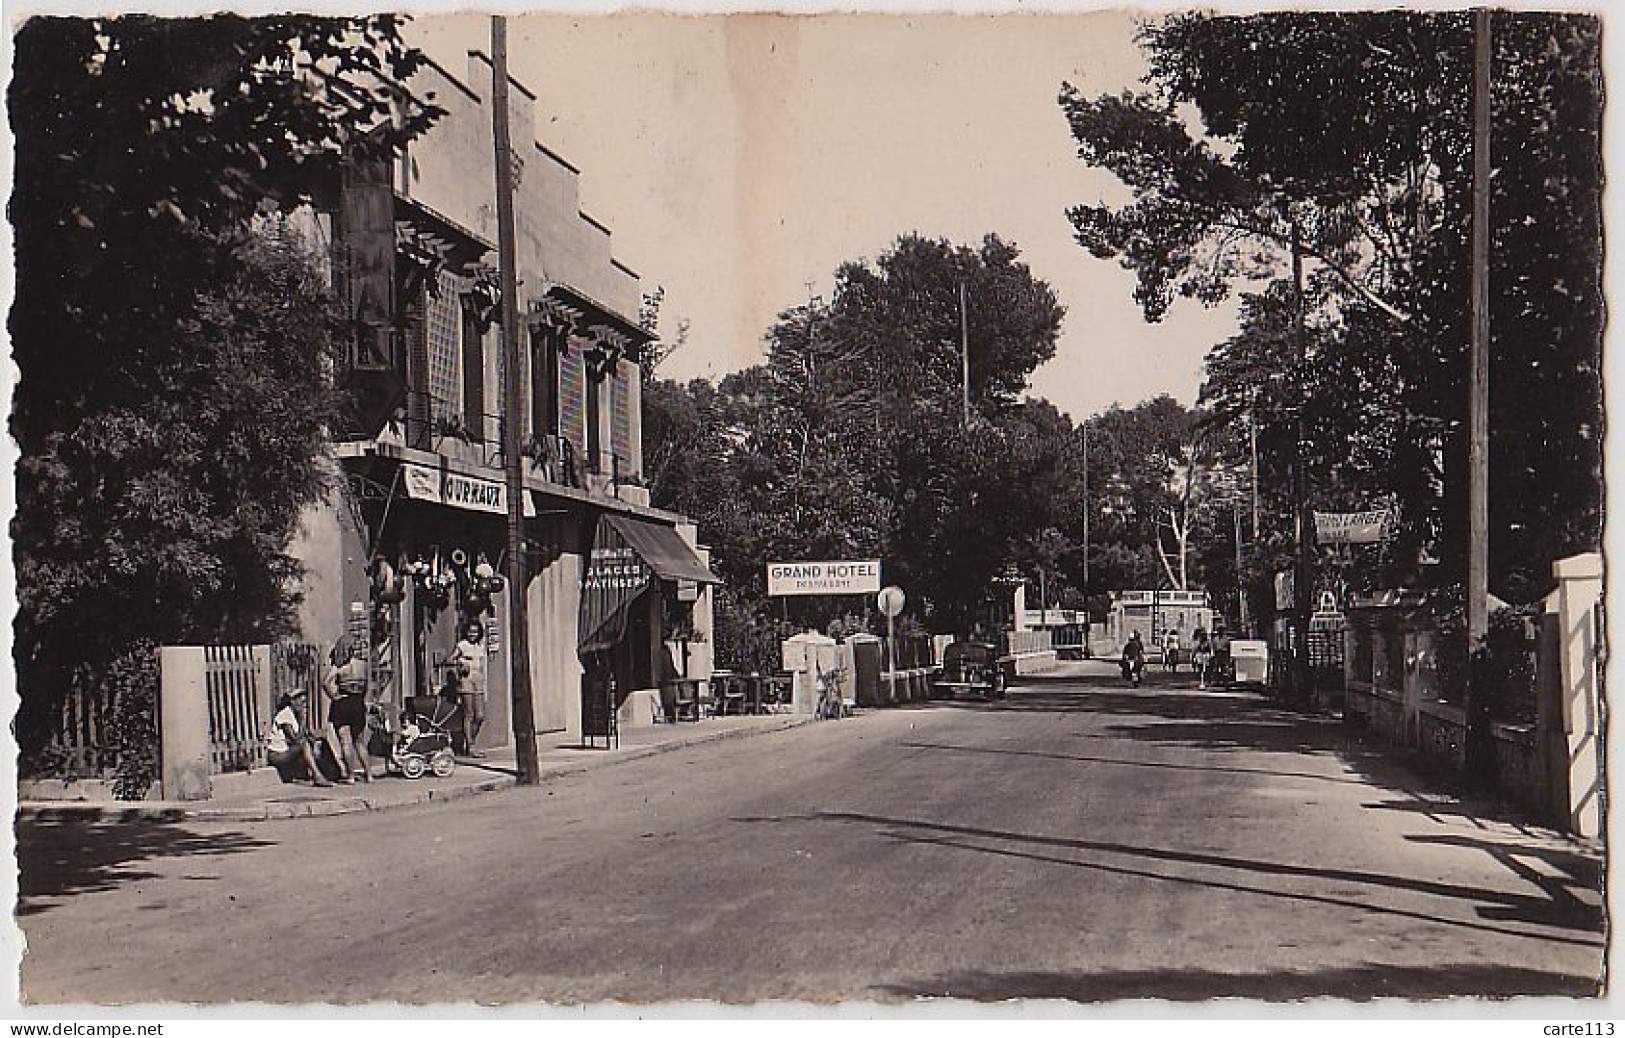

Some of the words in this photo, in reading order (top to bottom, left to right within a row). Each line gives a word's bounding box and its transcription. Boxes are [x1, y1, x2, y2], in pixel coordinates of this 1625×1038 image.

[441, 477, 500, 507] OURNAUX
[772, 565, 821, 579] GRAND
[828, 565, 876, 578] HOTEL
